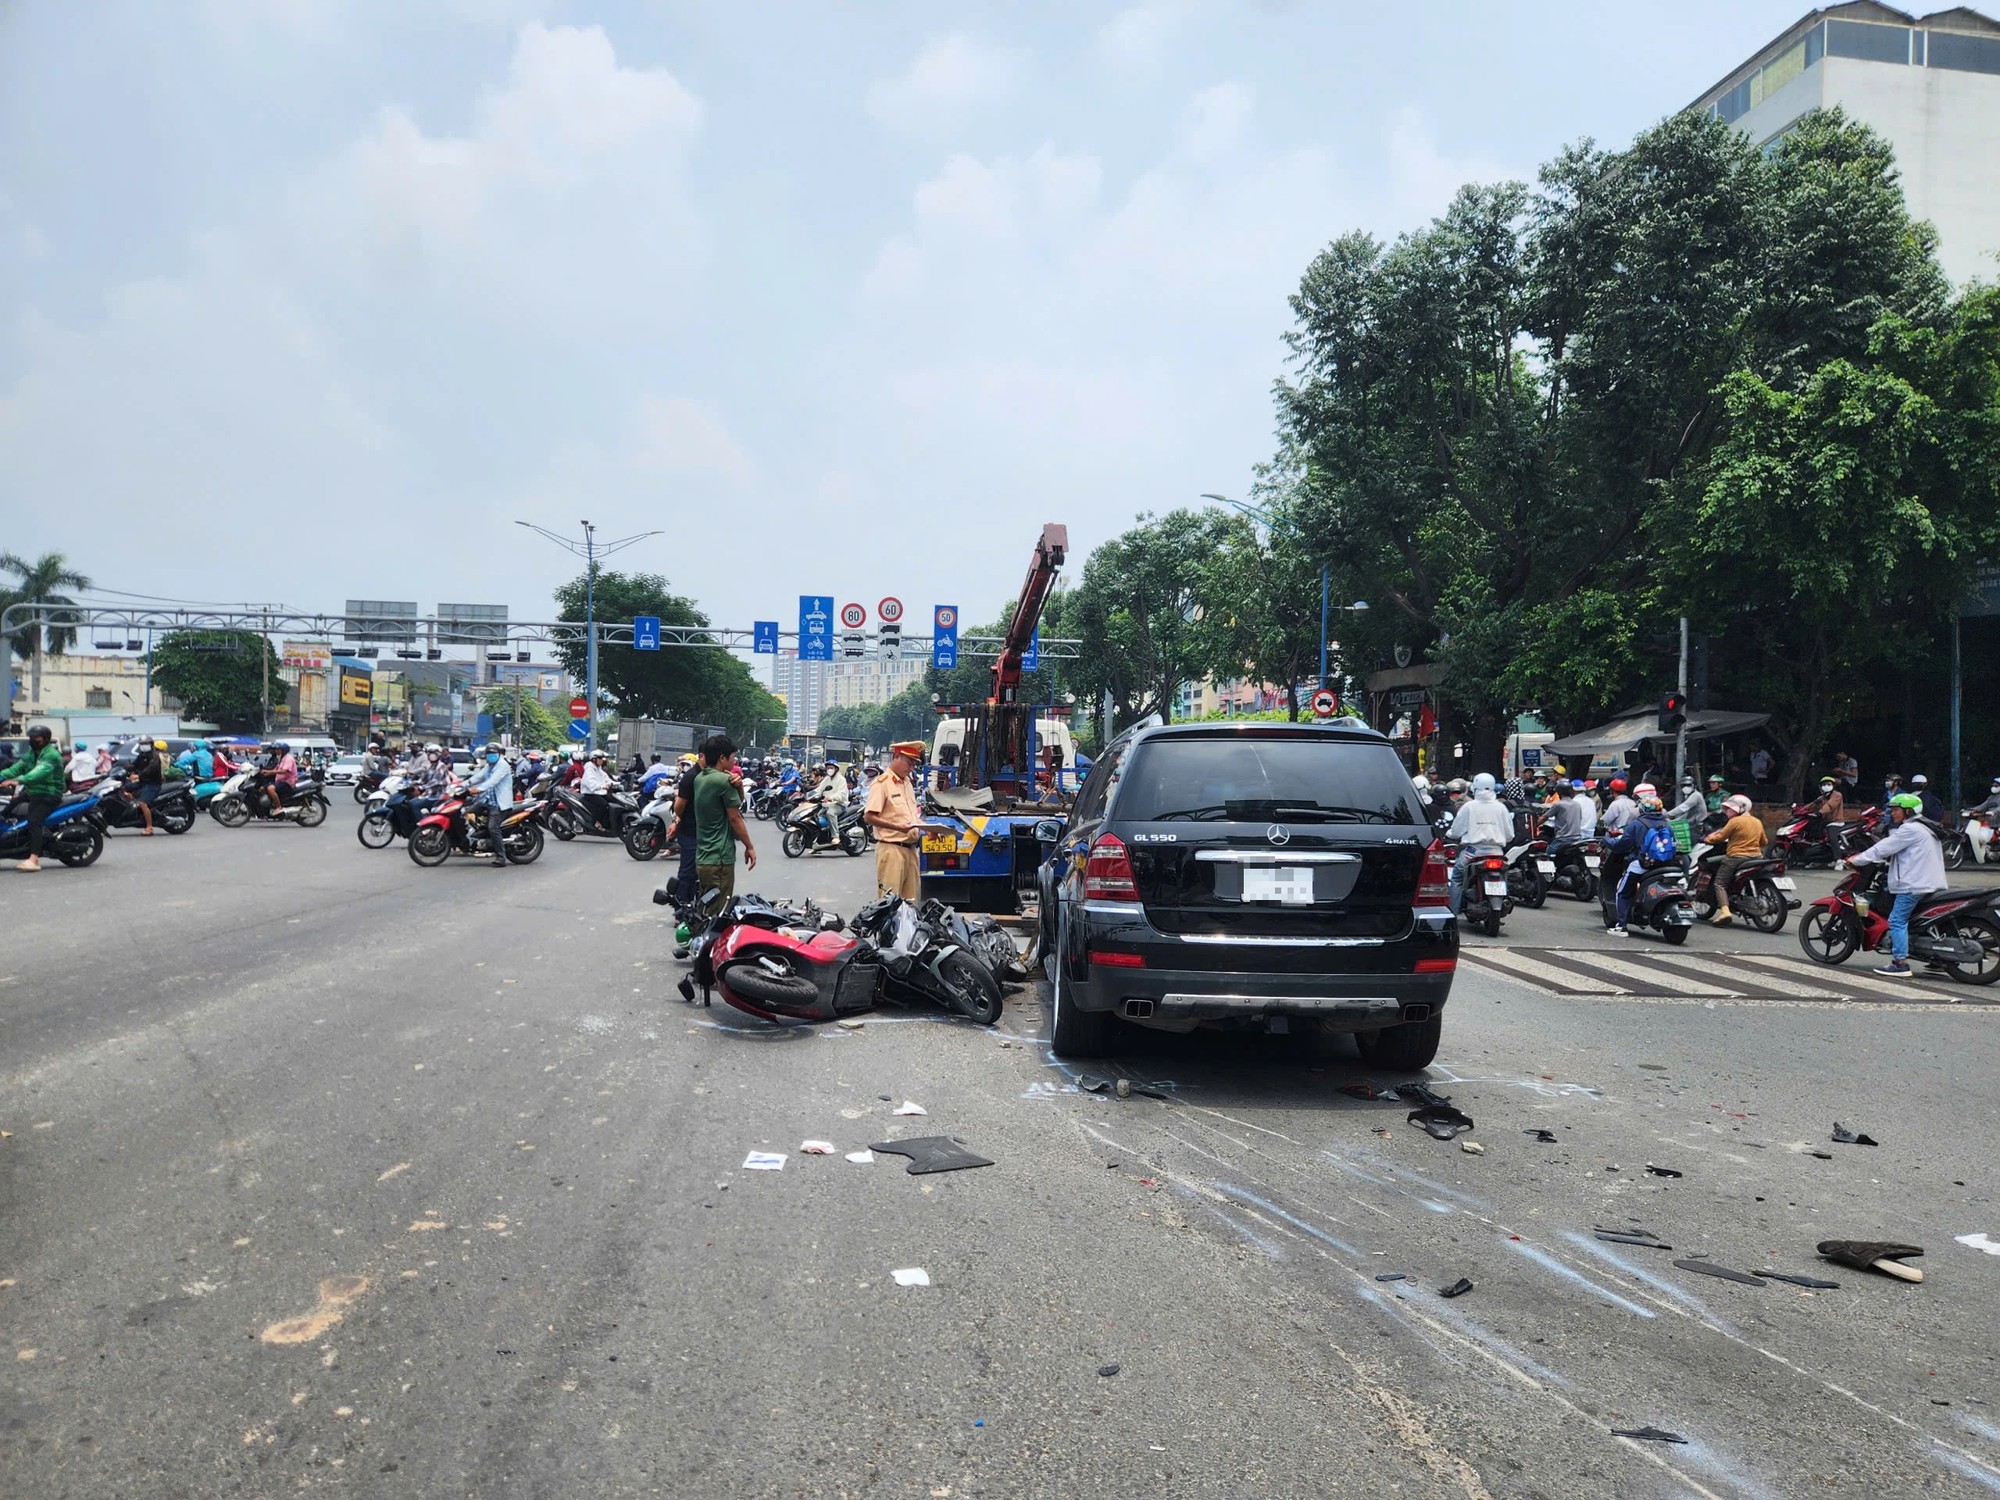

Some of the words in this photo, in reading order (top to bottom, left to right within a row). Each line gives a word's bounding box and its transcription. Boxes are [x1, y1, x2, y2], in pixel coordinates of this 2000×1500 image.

[885, 605, 896, 616] 60
[848, 611, 860, 622] 80
[941, 613, 951, 622] 50
[1134, 834, 1149, 842] GL
[1150, 834, 1177, 842] 550
[1385, 837, 1418, 845] 4MATIC
[925, 844, 952, 852] 543.50
